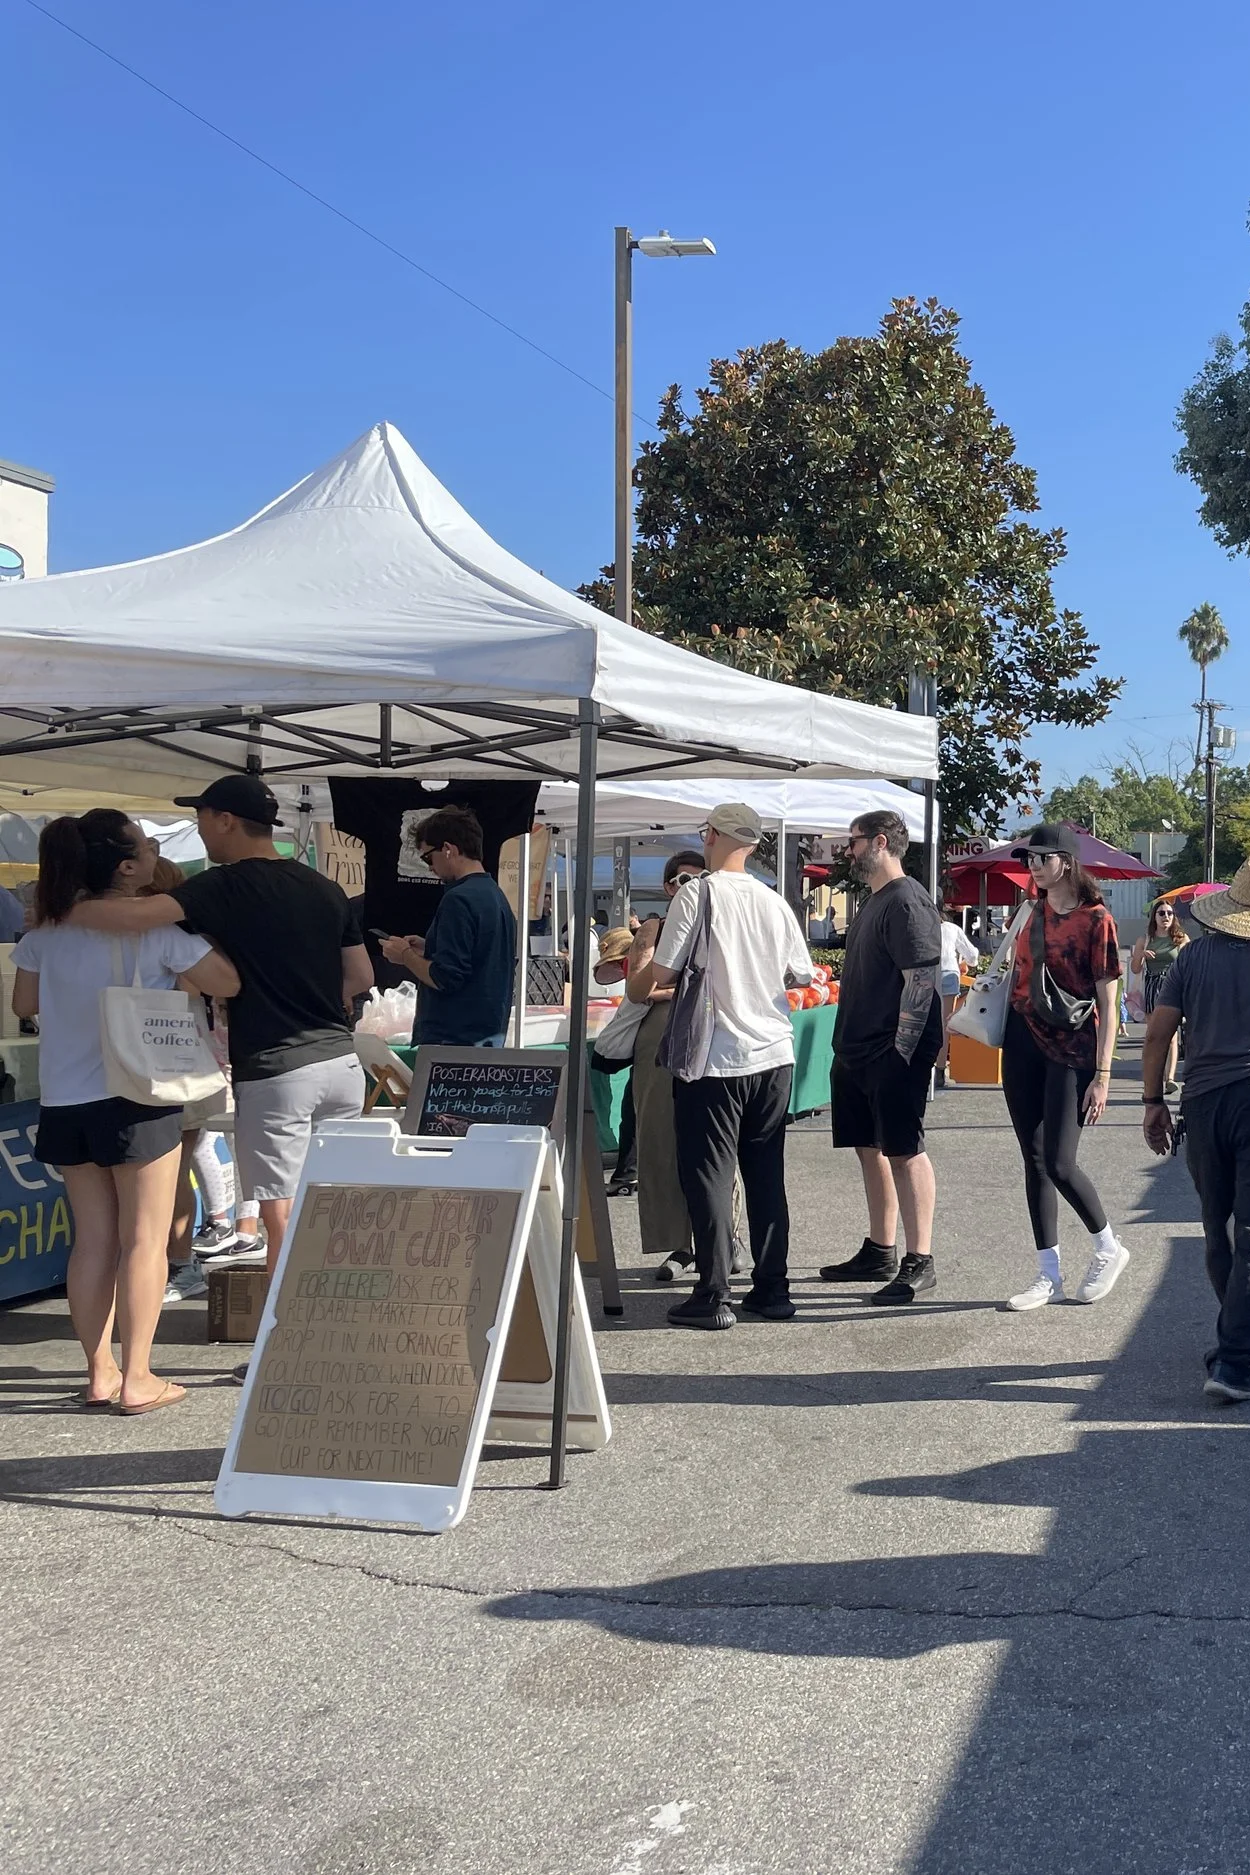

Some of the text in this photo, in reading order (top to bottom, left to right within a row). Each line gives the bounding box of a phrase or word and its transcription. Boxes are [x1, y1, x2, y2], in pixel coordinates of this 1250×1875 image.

[142, 1031, 193, 1047] Coffee
[429, 1083, 467, 1097] When
[510, 1083, 526, 1096] for
[535, 1084, 559, 1097] shot
[426, 1100, 452, 1113] but
[452, 1101, 472, 1113] the
[308, 1190, 499, 1234] FORGOT YOUR
[326, 1230, 481, 1268] OWN CUP?
[298, 1273, 330, 1297] FOR
[390, 1275, 423, 1300] ASK
[430, 1276, 459, 1301] FOR
[469, 1277, 481, 1302] A
[286, 1299, 363, 1324] REUSABLE
[369, 1302, 429, 1326] MARKET
[272, 1329, 462, 1357] DROP IT IN AN ORANGE
[264, 1358, 354, 1384] COLLECTION
[354, 1362, 384, 1385] BOX
[390, 1363, 432, 1385] WHEN
[264, 1388, 289, 1411] TO
[323, 1391, 359, 1413] ASK
[368, 1392, 400, 1415] FOR
[406, 1395, 420, 1416] A
[435, 1396, 460, 1417] TO
[254, 1416, 461, 1448] GO CUP. REMEMBER YOUR
[280, 1444, 434, 1475] CUP FOR NEXT TIME!
